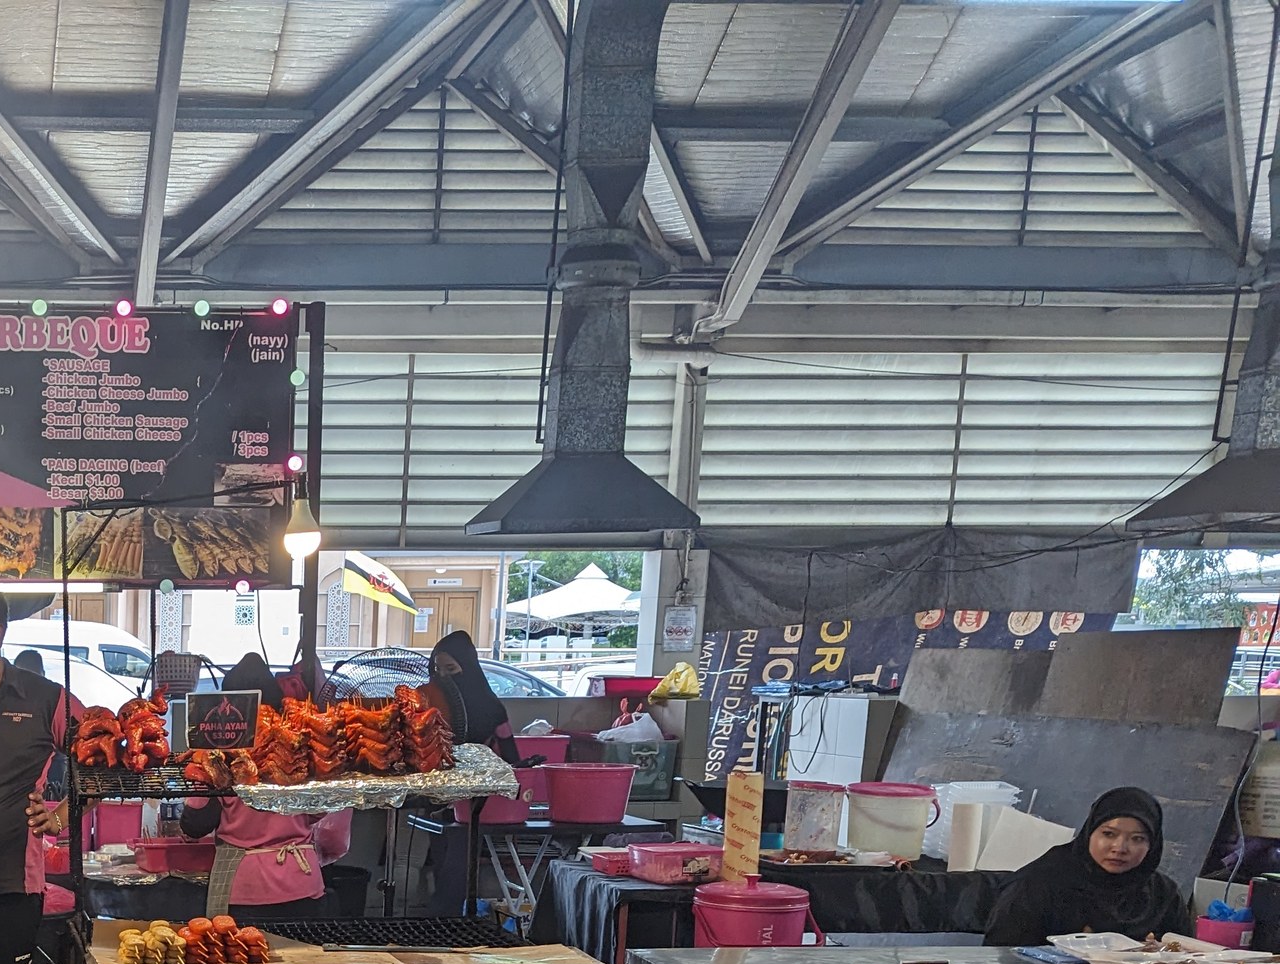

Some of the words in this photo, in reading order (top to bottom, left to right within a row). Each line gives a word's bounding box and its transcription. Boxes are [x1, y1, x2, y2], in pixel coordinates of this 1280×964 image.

[248, 333, 289, 348] (nayy)
[251, 348, 285, 363] (jain)
[98, 375, 141, 387] Jumbo
[99, 389, 145, 400] Cheese
[146, 389, 189, 401] Jumbo
[78, 402, 121, 414] Jumbo
[83, 415, 133, 426] Chicken
[135, 416, 189, 429] Sausage
[83, 429, 134, 440] Chicken
[135, 429, 181, 441] Cheese
[239, 431, 269, 444] 1pcs
[238, 444, 269, 457] 3pcs
[79, 459, 128, 472] DAGING
[130, 460, 167, 475] (beef)
[85, 474, 121, 487] $1.00
[88, 487, 124, 500] $3.00
[200, 722, 222, 730] PAHA
[224, 722, 248, 730] AYAM
